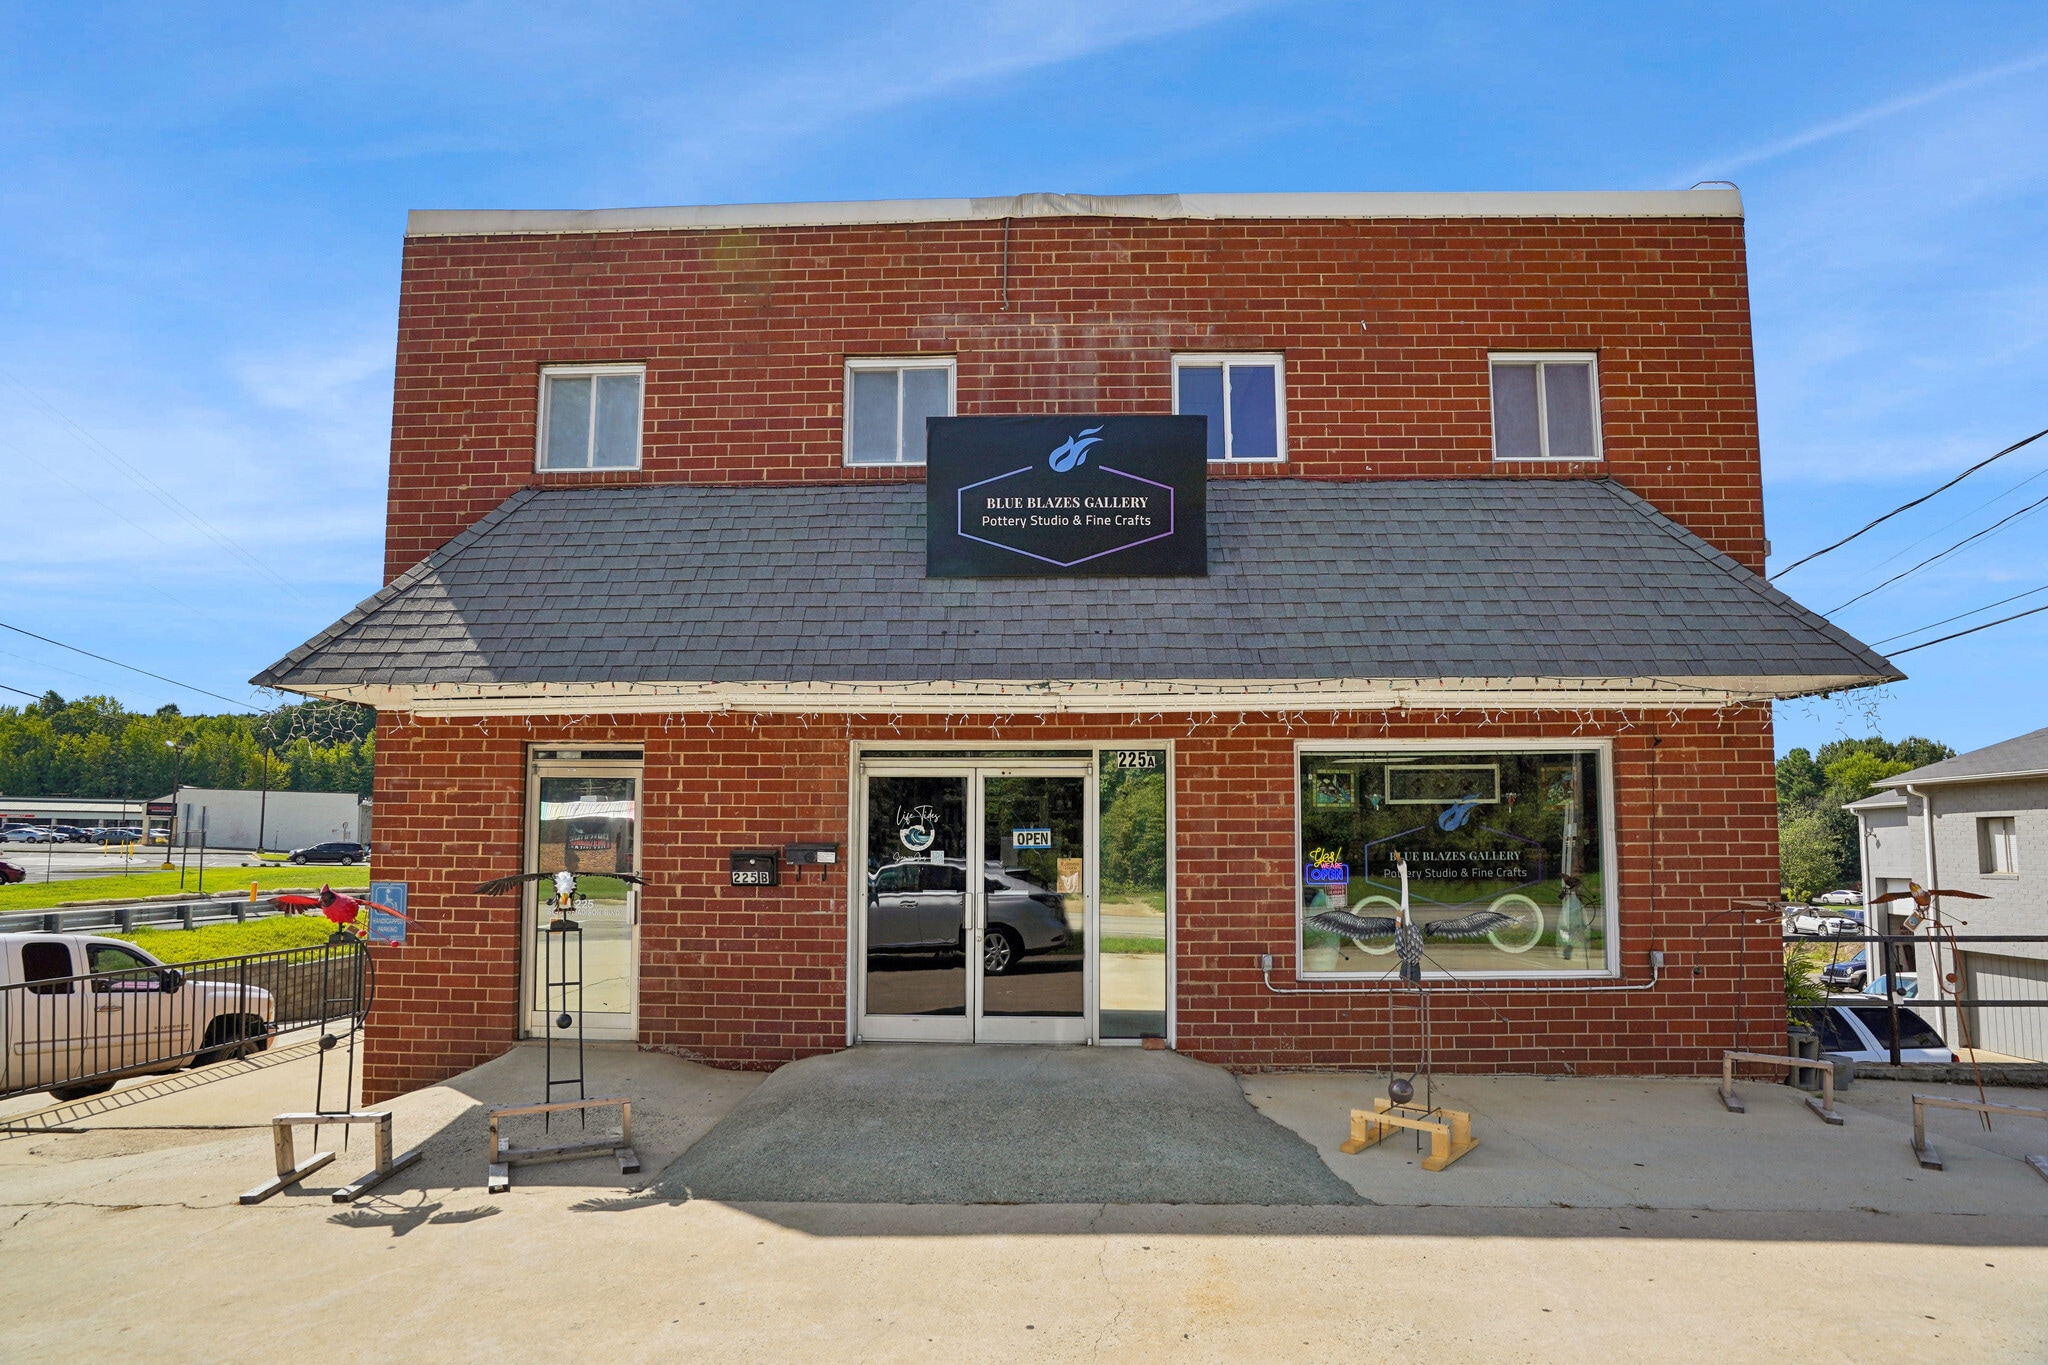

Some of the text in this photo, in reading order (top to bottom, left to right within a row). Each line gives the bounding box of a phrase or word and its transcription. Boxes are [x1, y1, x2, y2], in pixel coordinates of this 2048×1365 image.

[986, 496, 1149, 509] BLUE BLAZES GALLERY
[982, 514, 1151, 528] Pottery Studio & Fine Crafts
[1017, 832, 1049, 846] OPEN
[1309, 846, 1342, 868] Yes!
[1422, 851, 1466, 861] BLAZES
[1468, 850, 1521, 861] GALLERY
[1311, 868, 1344, 881] OPEN
[1425, 868, 1458, 878] Studio
[1460, 868, 1469, 878] &
[1472, 867, 1493, 878] Fine
[1496, 867, 1528, 878] Crafts
[575, 899, 594, 909] 225
[378, 925, 398, 933] PARKING
